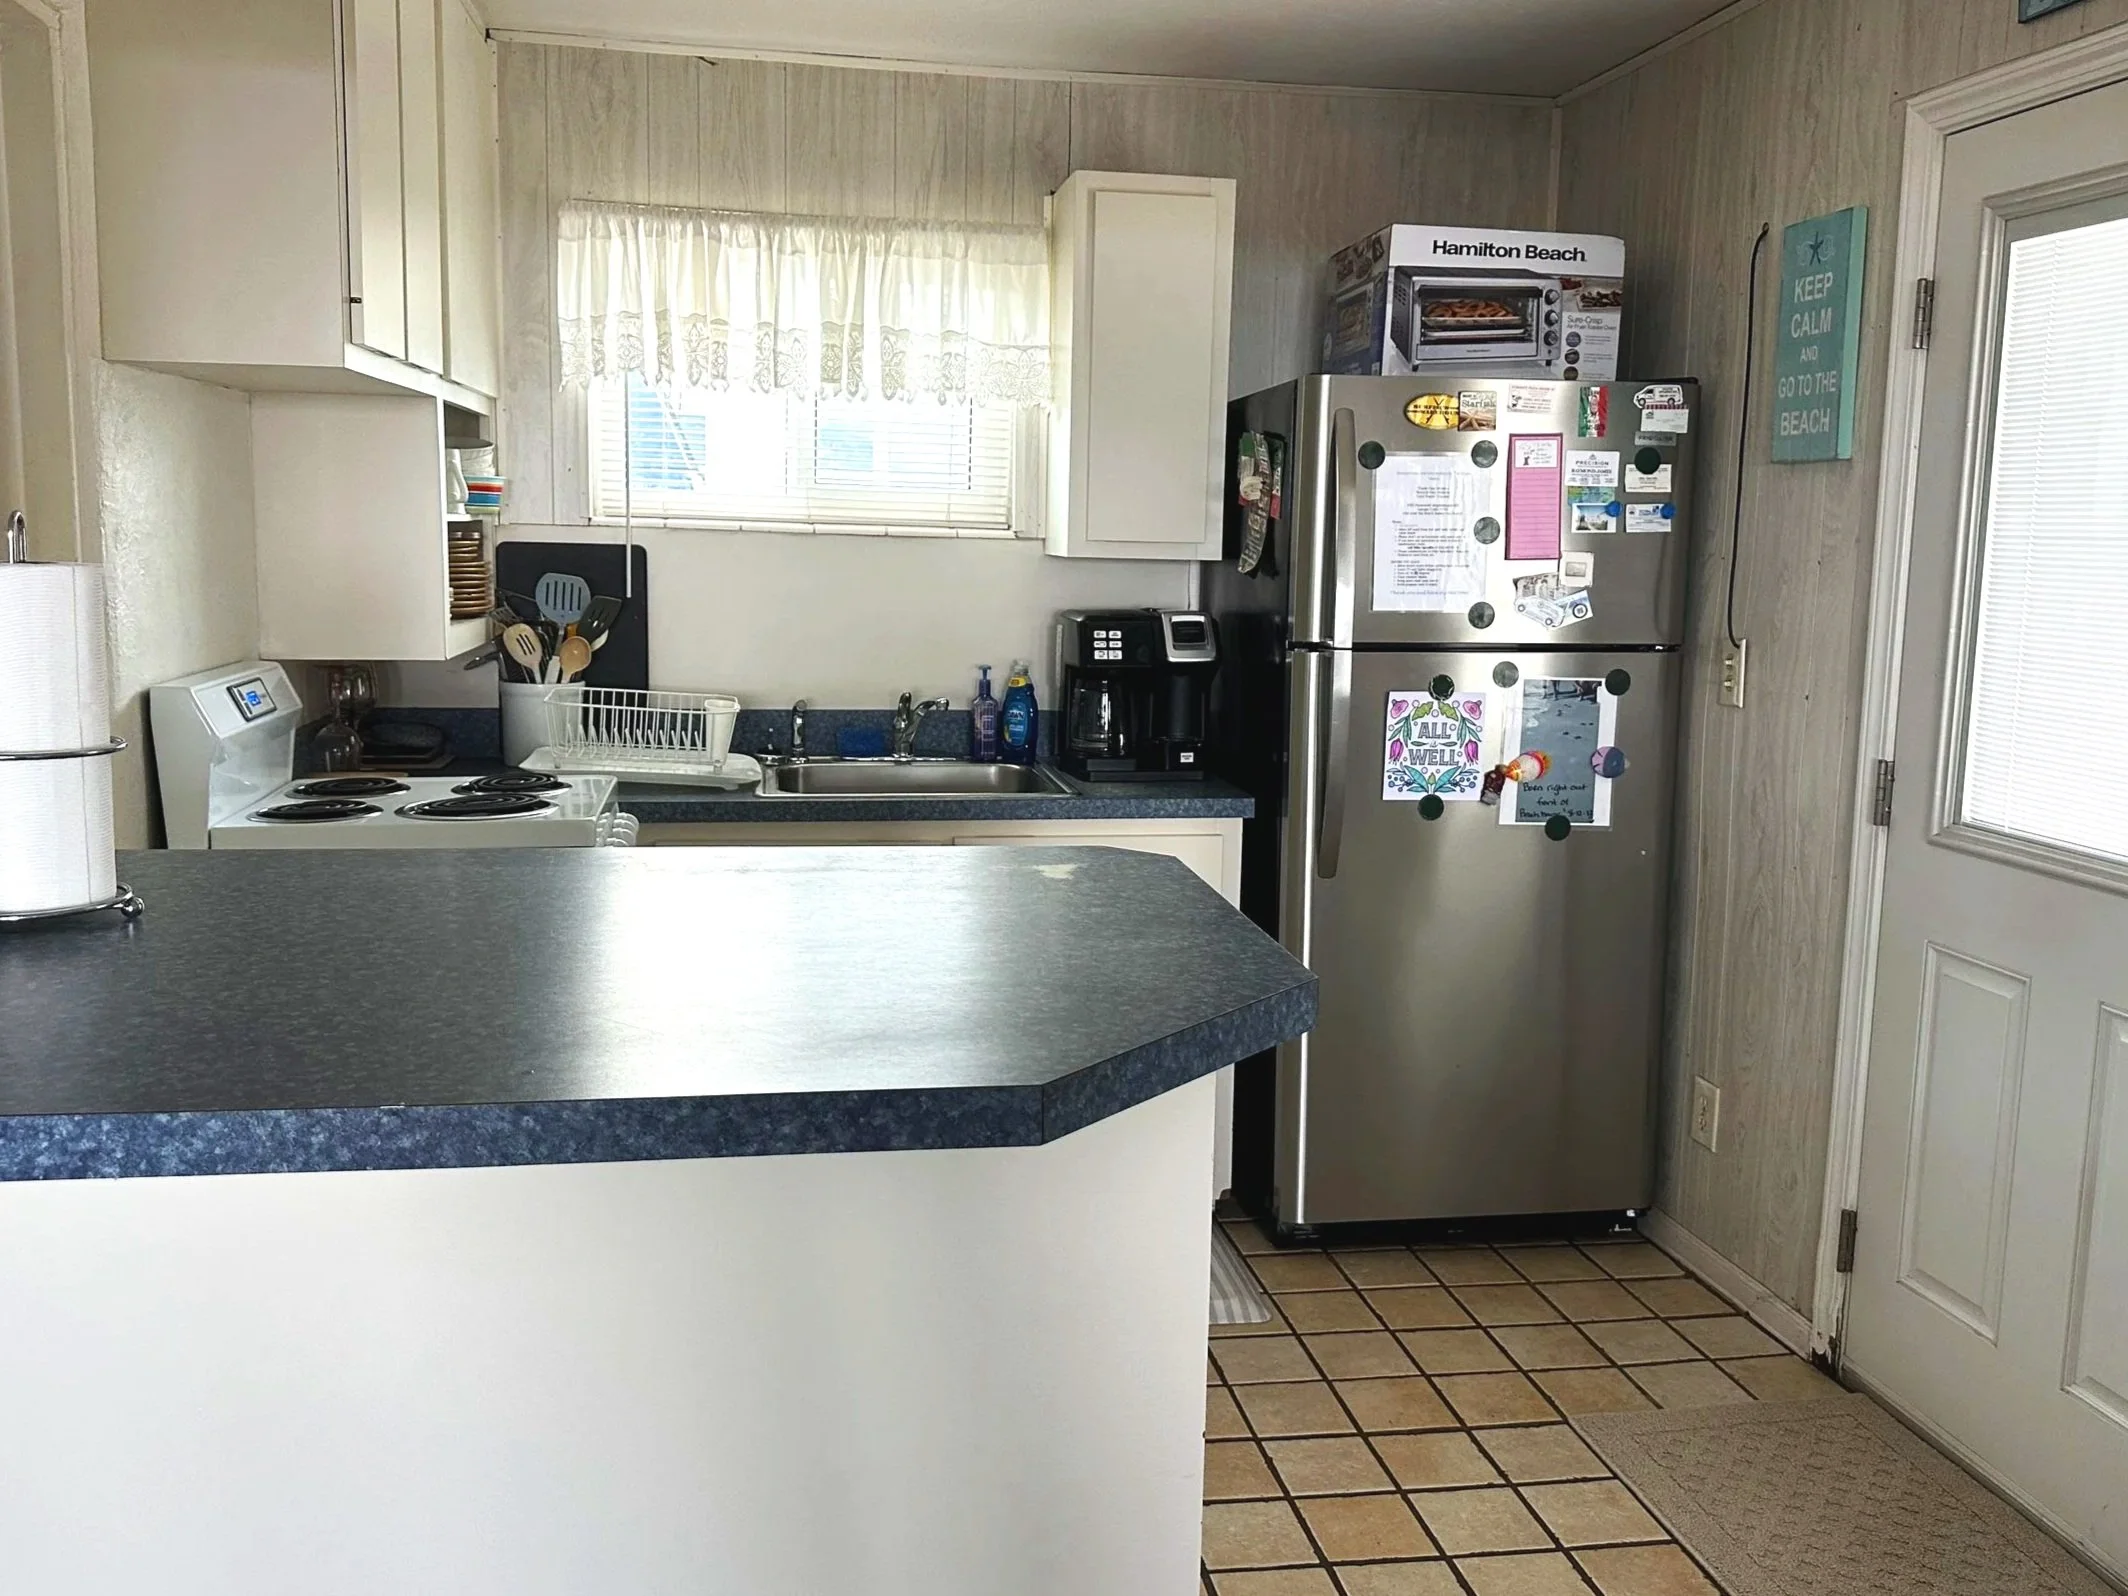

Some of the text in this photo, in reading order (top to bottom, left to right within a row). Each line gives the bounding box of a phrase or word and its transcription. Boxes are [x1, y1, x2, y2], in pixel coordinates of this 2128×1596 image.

[1432, 239, 1586, 262] Hamilton Beach
[1794, 271, 1833, 304] KEEP
[1791, 307, 1832, 338] CALM
[1800, 345, 1818, 362] AND
[1778, 370, 1837, 398] GO TO THE
[1780, 407, 1830, 436] BEACH
[1417, 721, 1452, 739] ALL
[1408, 748, 1460, 766] WELL
